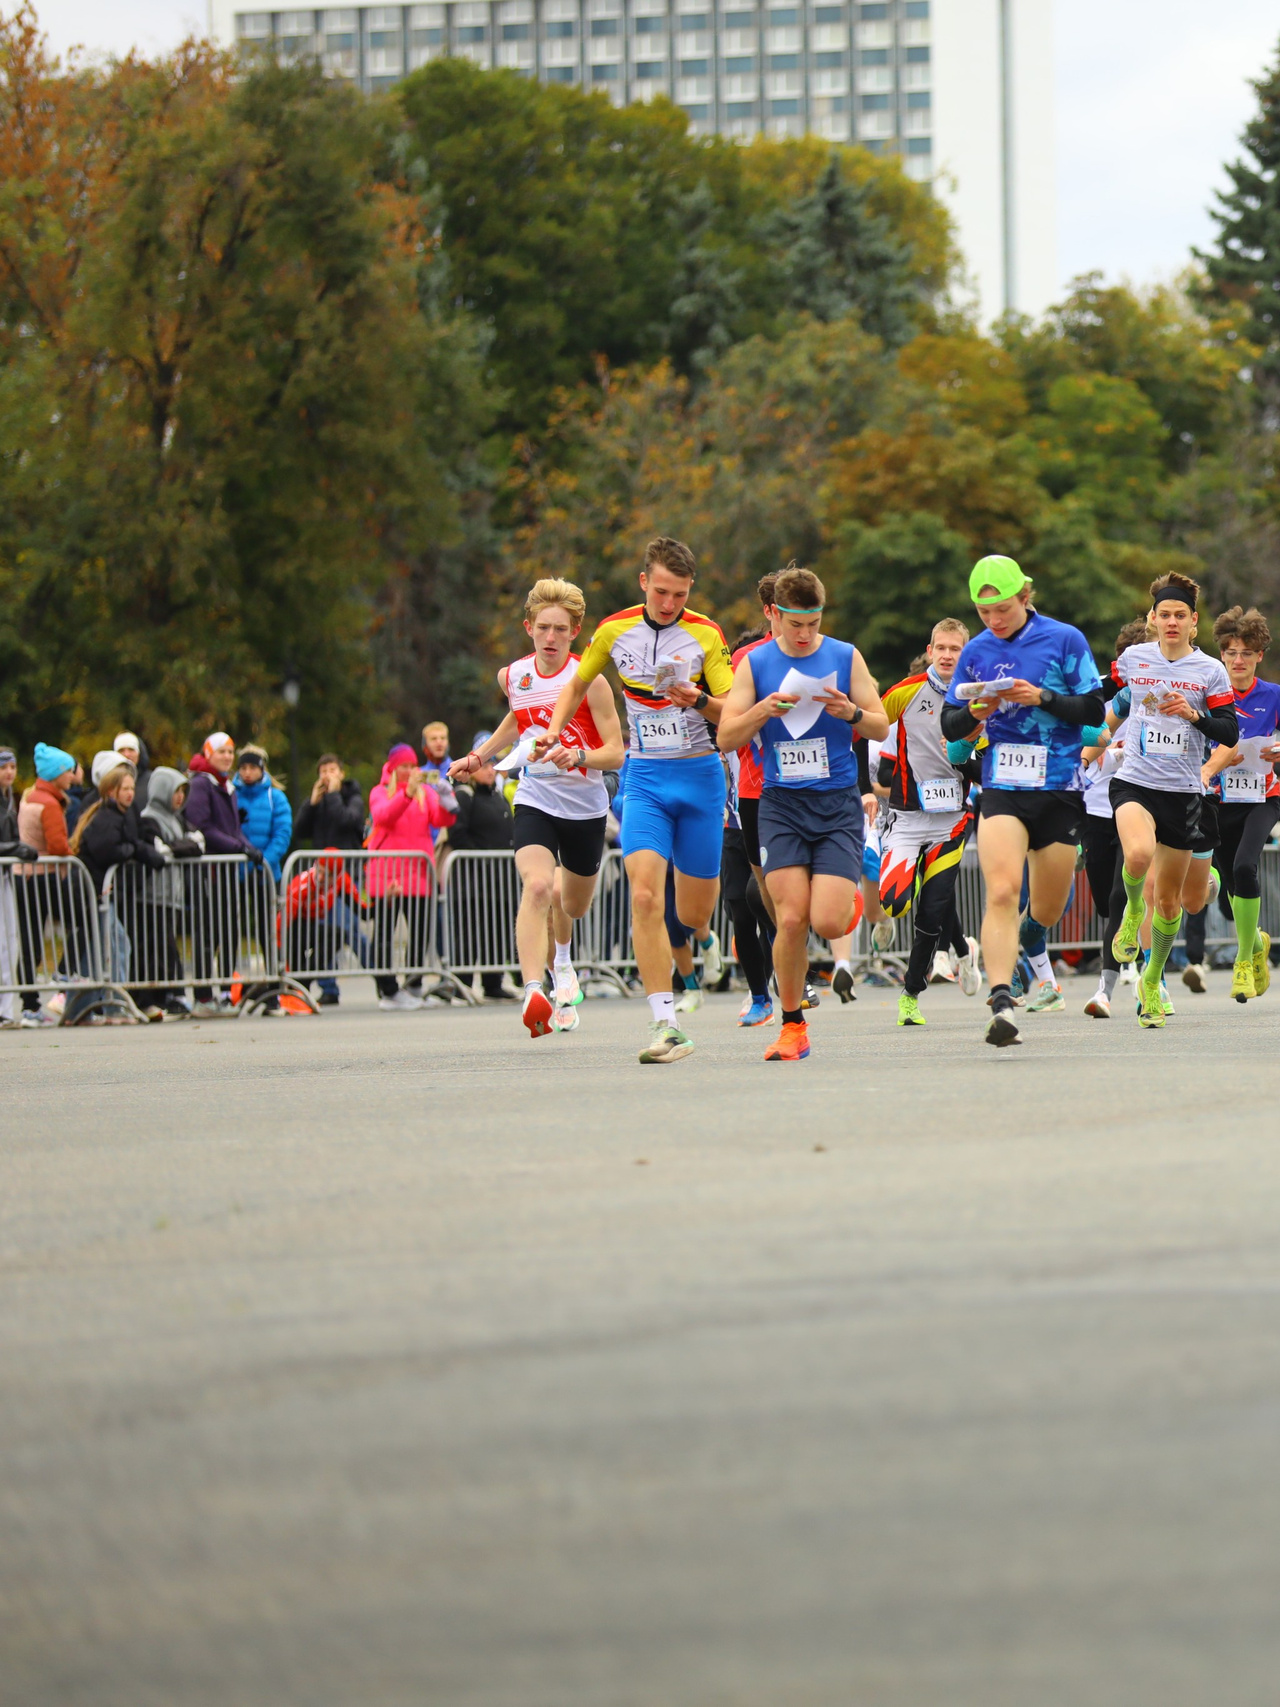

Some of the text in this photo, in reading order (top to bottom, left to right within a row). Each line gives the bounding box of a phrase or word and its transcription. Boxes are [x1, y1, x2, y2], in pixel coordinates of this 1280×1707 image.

[1171, 681, 1208, 692] WEST
[538, 709, 551, 723] Ru
[560, 728, 577, 743] nd
[641, 722, 679, 738] 236.1
[1147, 731, 1181, 745] 216.1
[781, 750, 819, 765] 220.1
[999, 752, 1036, 768] 219.1
[1227, 777, 1258, 789] 213.1
[925, 787, 955, 800] 230.1
